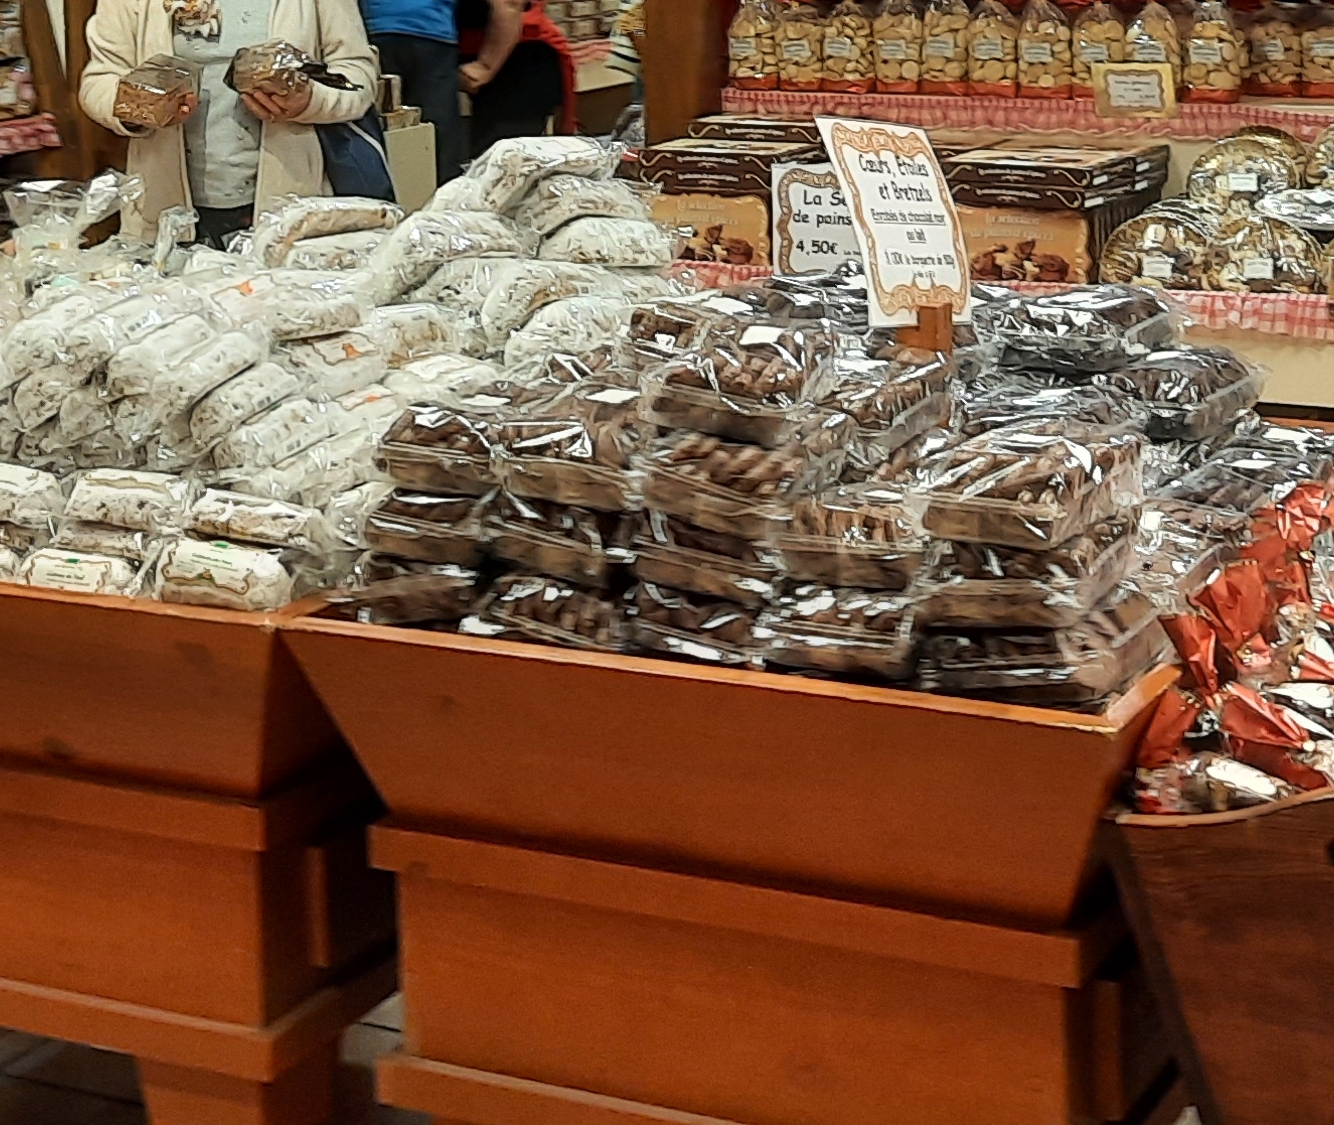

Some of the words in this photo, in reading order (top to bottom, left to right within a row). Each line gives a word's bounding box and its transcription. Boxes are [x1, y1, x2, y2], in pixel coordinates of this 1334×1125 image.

[803, 189, 822, 205] La
[878, 182, 891, 200] et
[890, 180, 932, 202] Bretzels
[793, 209, 809, 223] de
[816, 211, 852, 228] pains
